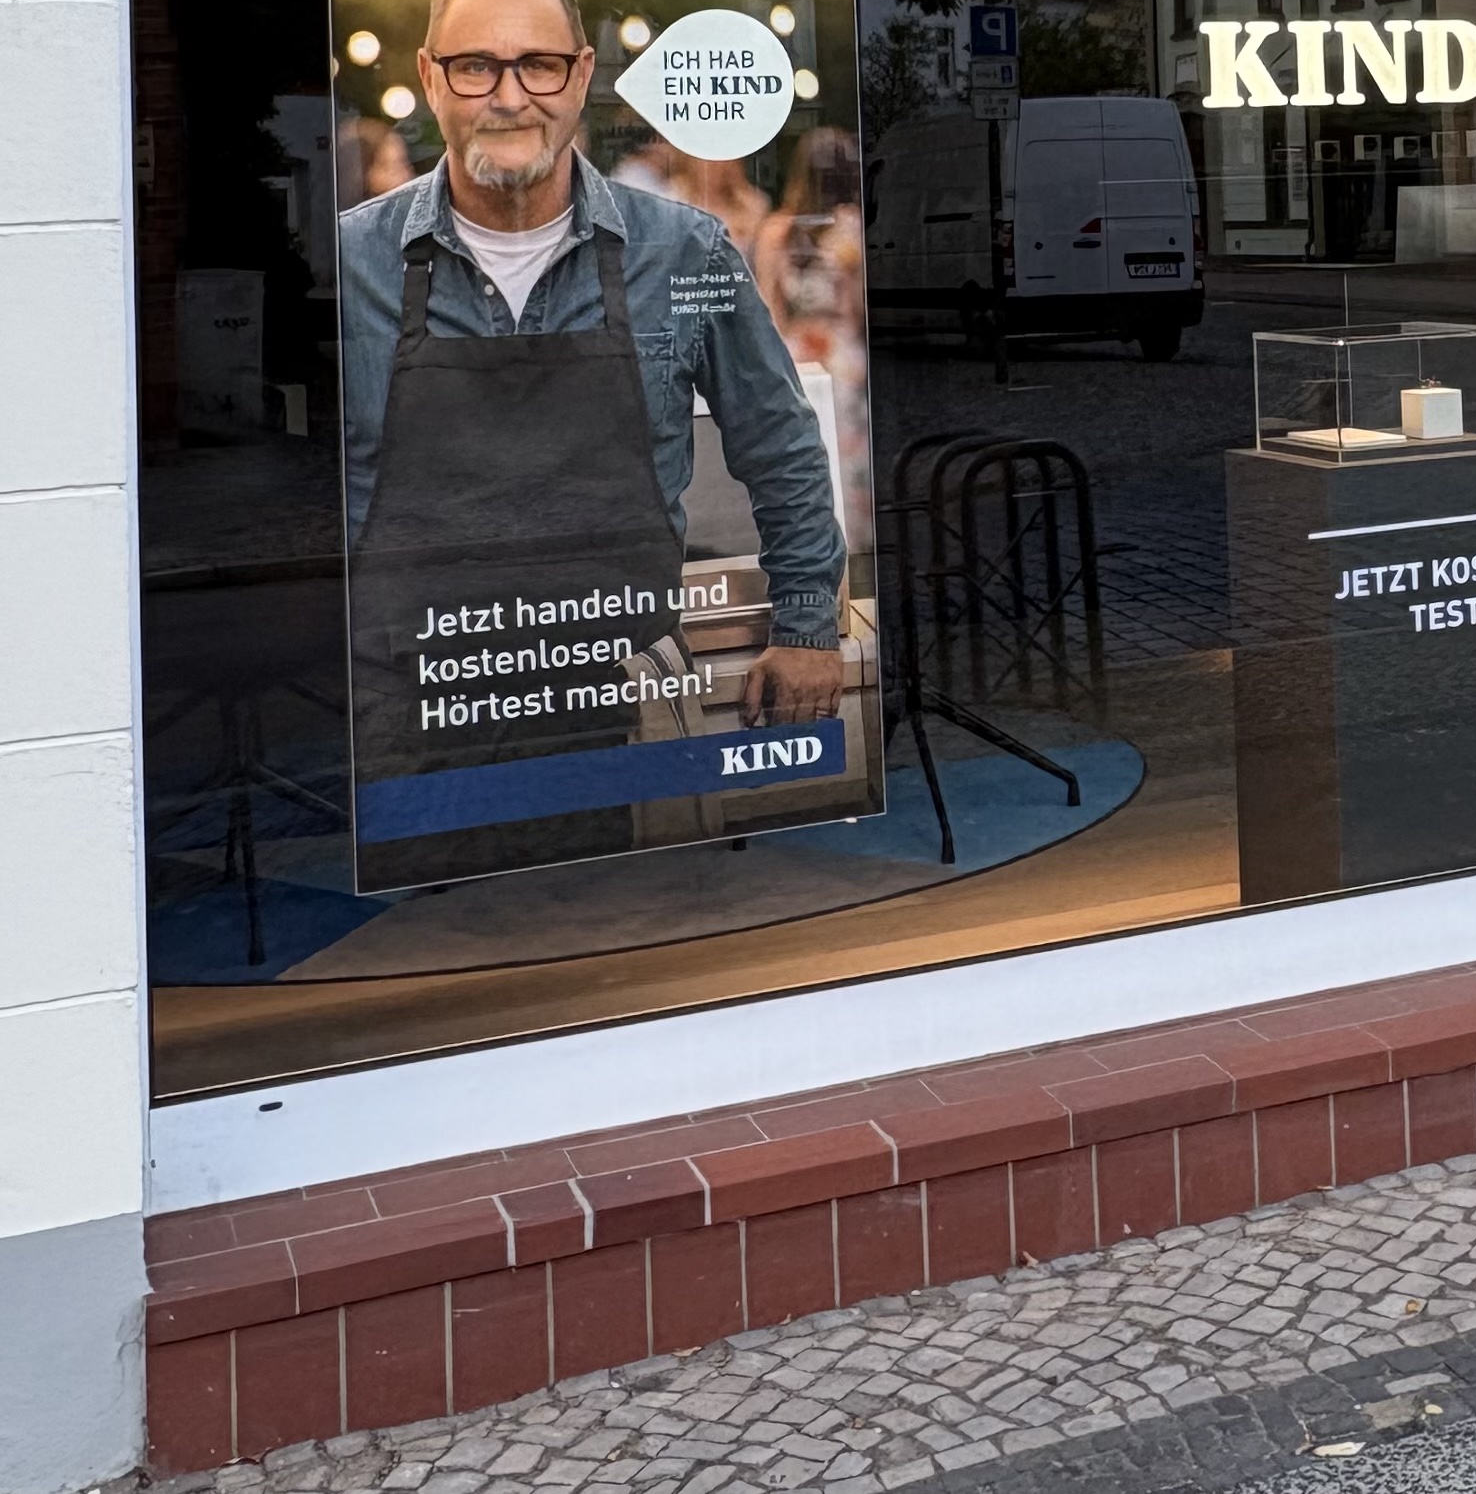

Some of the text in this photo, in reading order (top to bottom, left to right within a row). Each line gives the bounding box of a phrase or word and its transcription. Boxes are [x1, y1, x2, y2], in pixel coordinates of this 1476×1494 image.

[662, 50, 755, 70] ICH HAB
[664, 75, 783, 96] EIN KIND
[665, 102, 746, 122] IM OHR
[1334, 561, 1424, 600] JETZT
[416, 575, 730, 640] Jetzt handeln und
[418, 636, 634, 686] kostenlosen
[420, 664, 713, 731] Hörtest machen!
[720, 735, 823, 776] KIND
